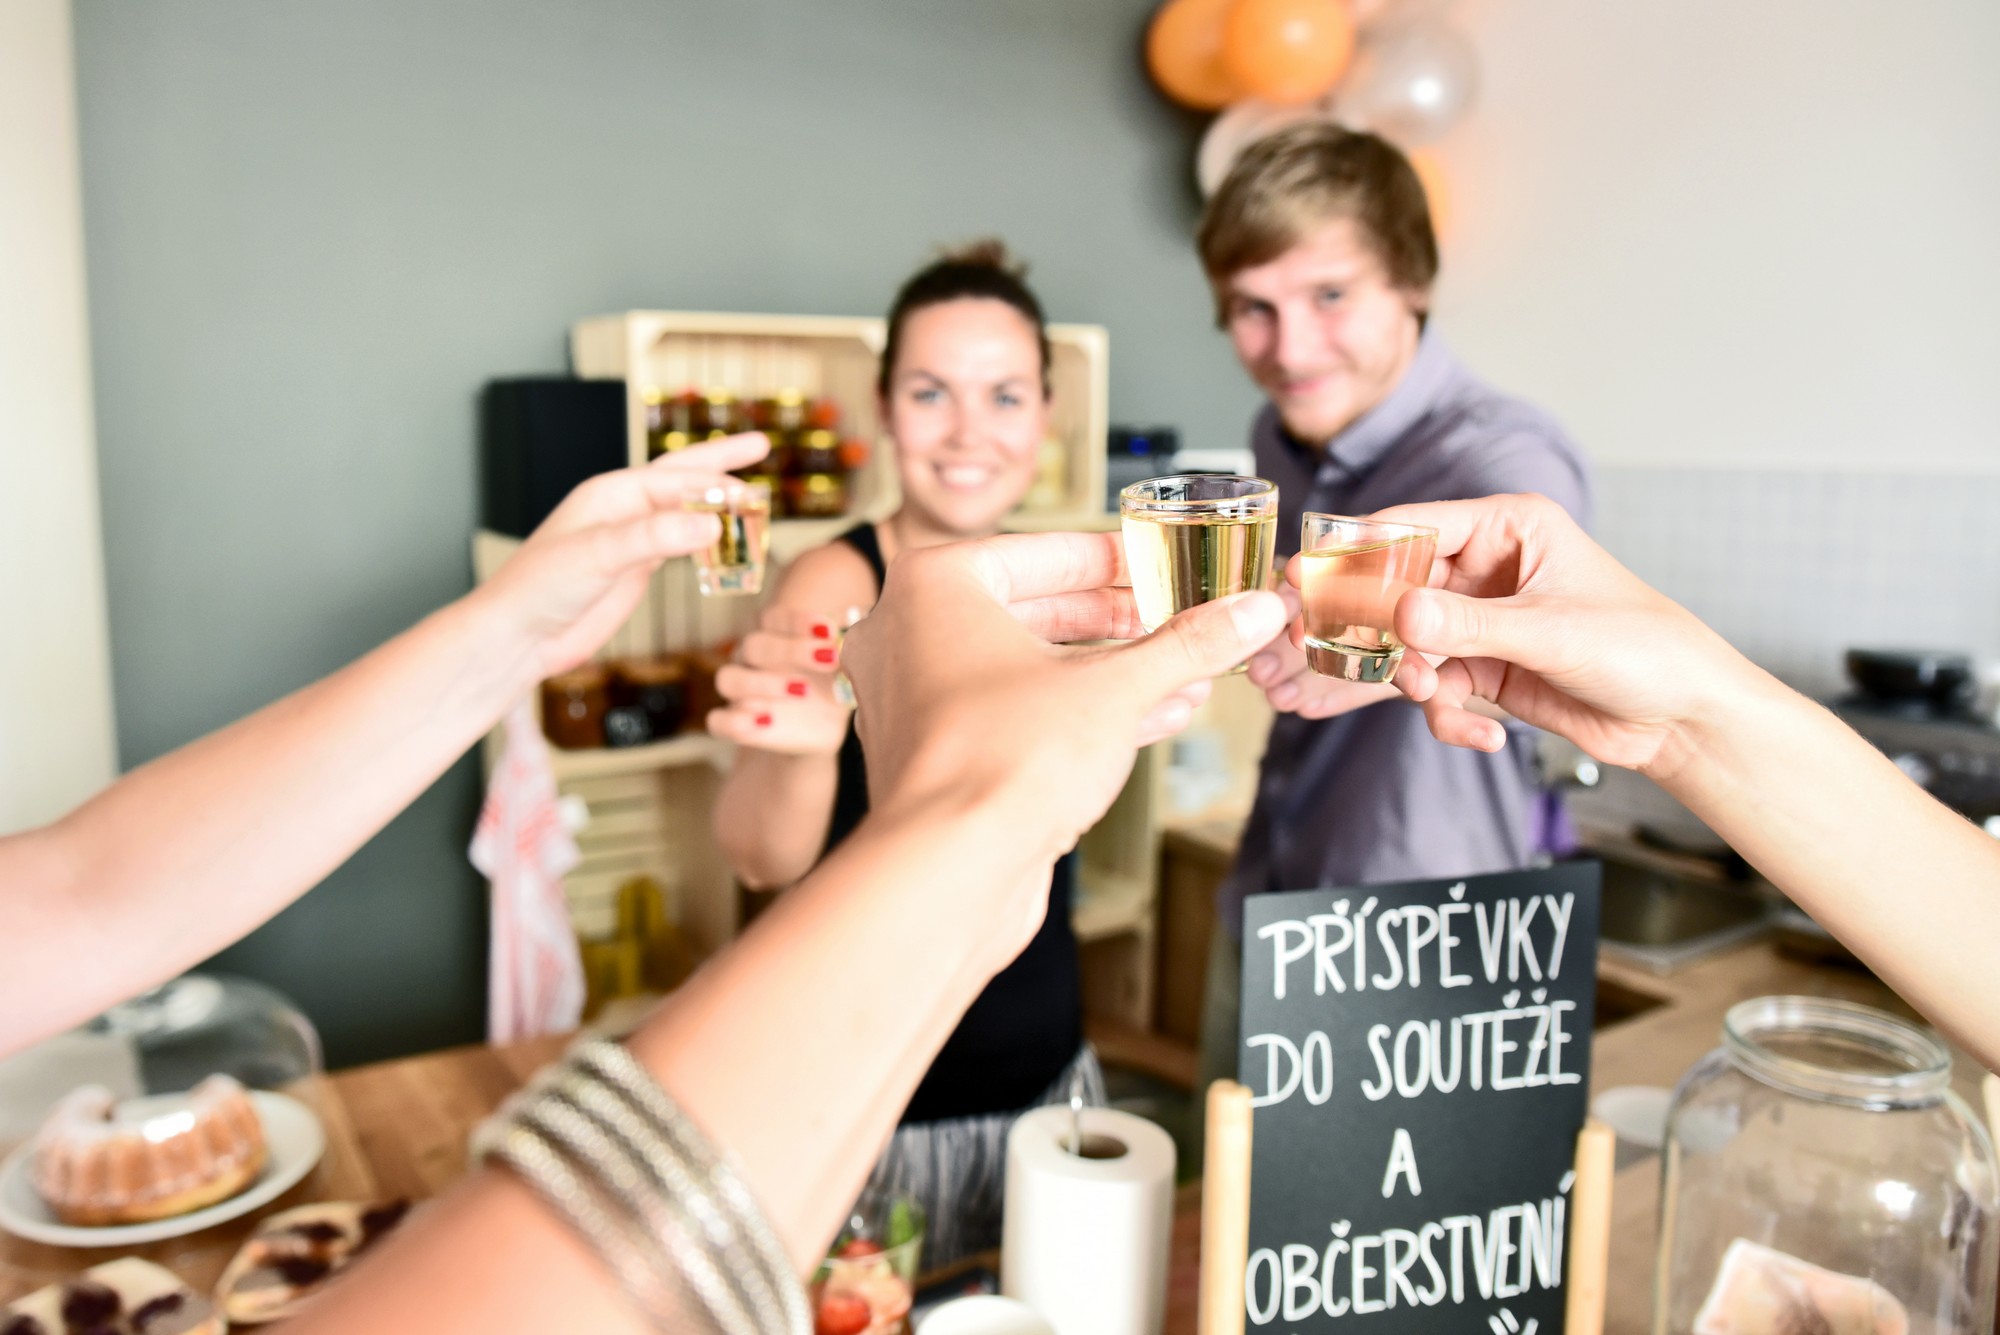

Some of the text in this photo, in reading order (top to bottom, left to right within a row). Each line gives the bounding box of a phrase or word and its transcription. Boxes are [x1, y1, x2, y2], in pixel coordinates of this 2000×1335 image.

[1257, 882, 1575, 999] PŘÍSPĚVKY
[1246, 988, 1582, 1108] DO SOUTĚŽE
[1382, 1128, 1422, 1198] A
[1244, 1170, 1577, 1325] OBČERSTVENÍ
